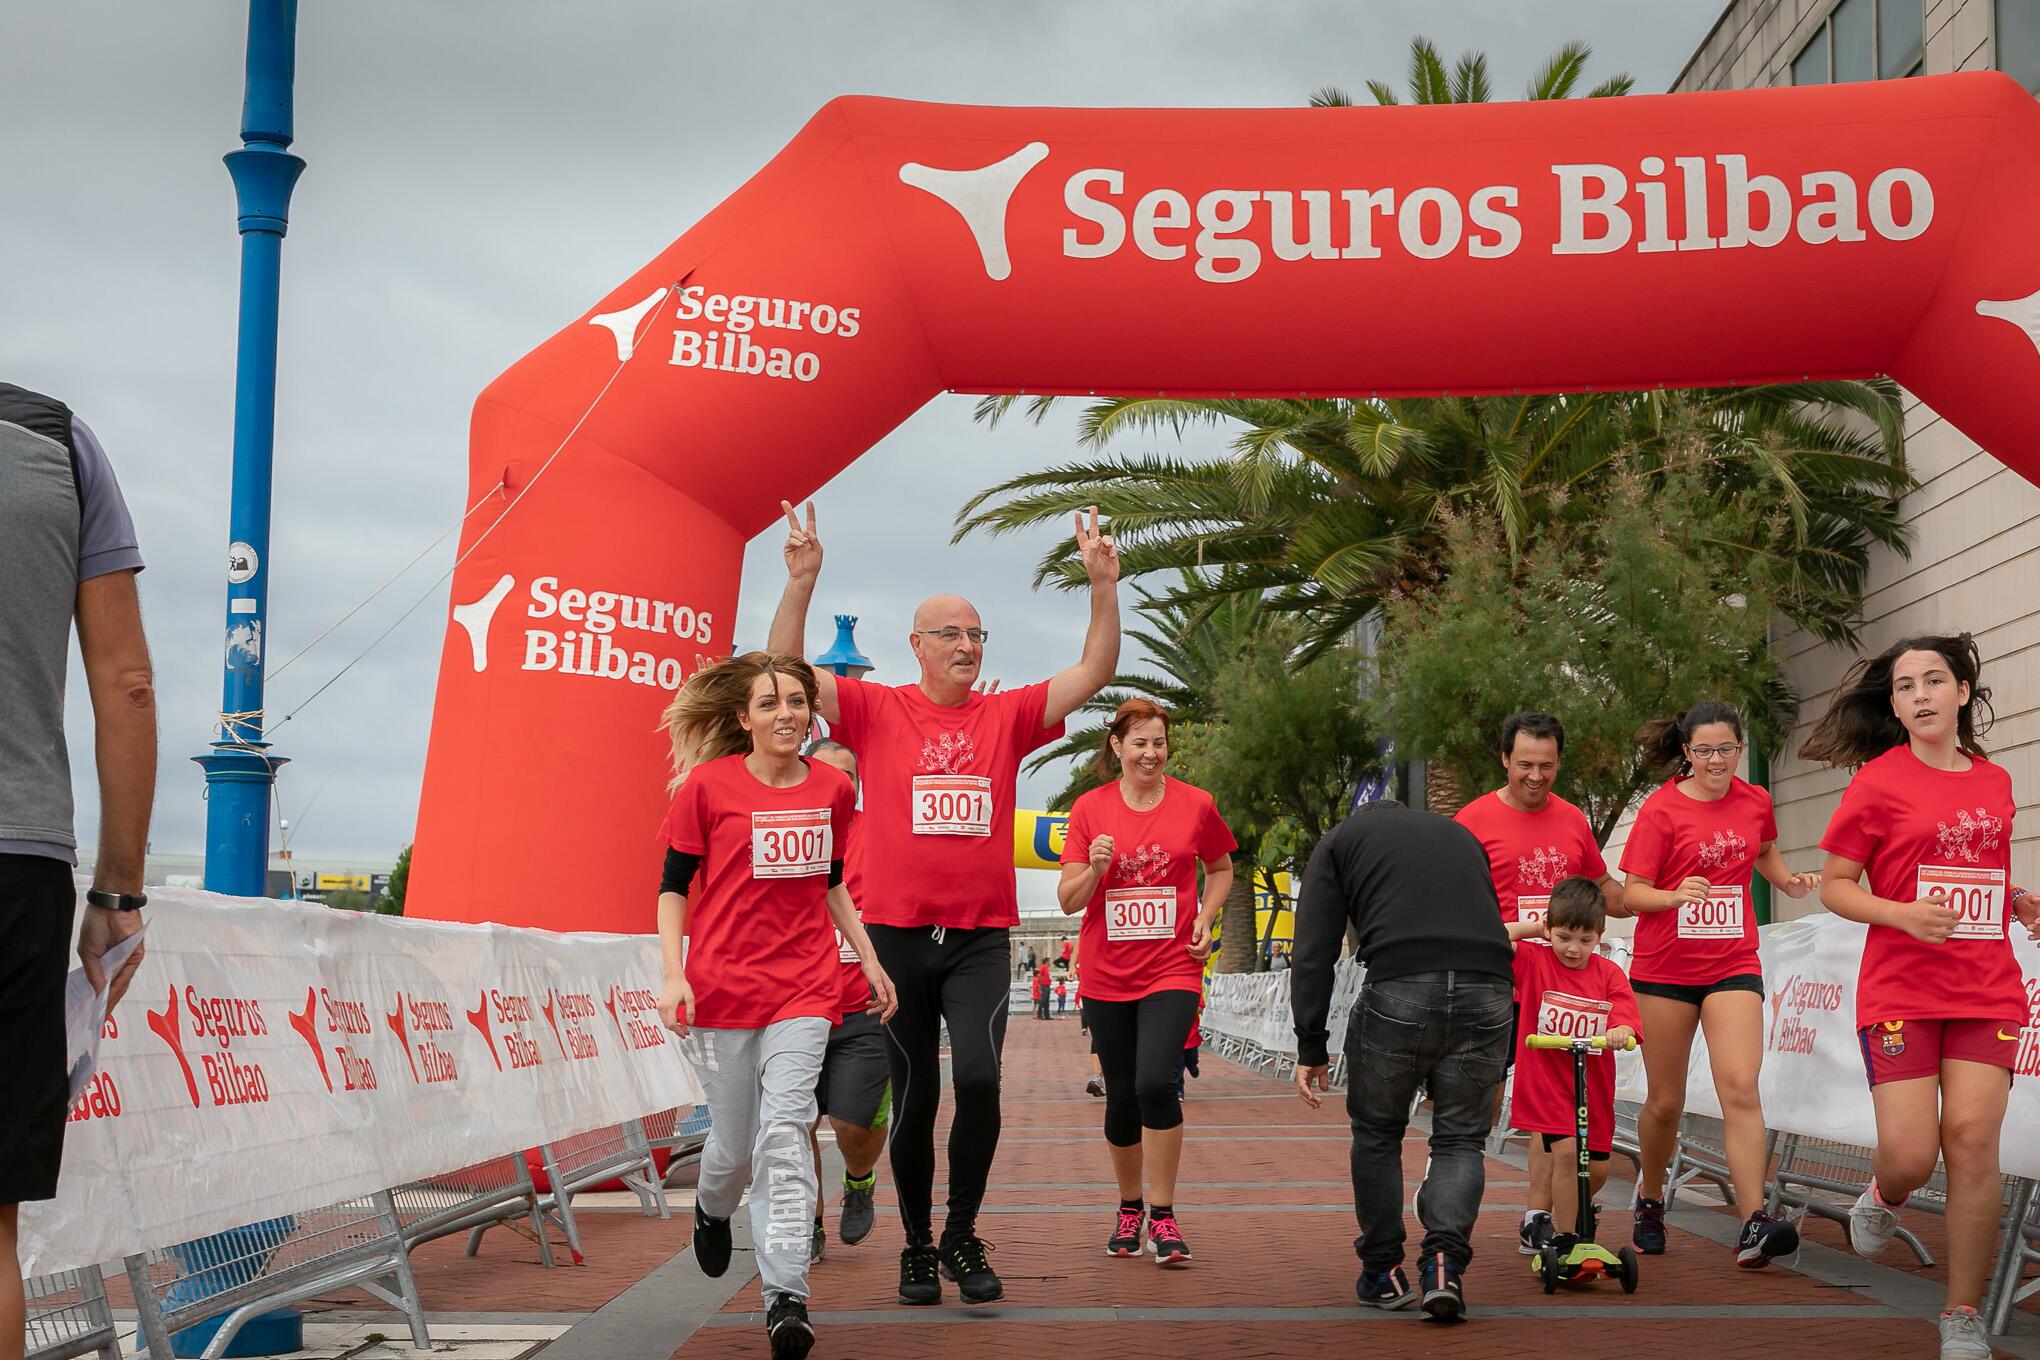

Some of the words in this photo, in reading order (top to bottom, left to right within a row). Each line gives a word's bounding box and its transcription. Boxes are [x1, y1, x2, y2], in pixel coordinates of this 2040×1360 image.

[1063, 168, 1522, 283] Seguros
[1551, 154, 1935, 254] Bilbao
[676, 286, 860, 338] Seguros
[669, 330, 820, 382] Bilbao
[528, 576, 712, 644] Seguros
[522, 629, 682, 691] Bilbao
[921, 793, 983, 822] 3001
[764, 829, 824, 863] 3001
[1114, 902, 1167, 927] 3001
[1687, 901, 1736, 925] 3001
[1787, 975, 1843, 1015] Seguros
[185, 985, 267, 1049] Seguros
[627, 1020, 665, 1050] Bilbao
[1545, 1008, 1599, 1039] 3001
[1778, 1017, 1817, 1055] Bilbao
[201, 1052, 269, 1106] Bilbao
[418, 1042, 457, 1083] Bilbao
